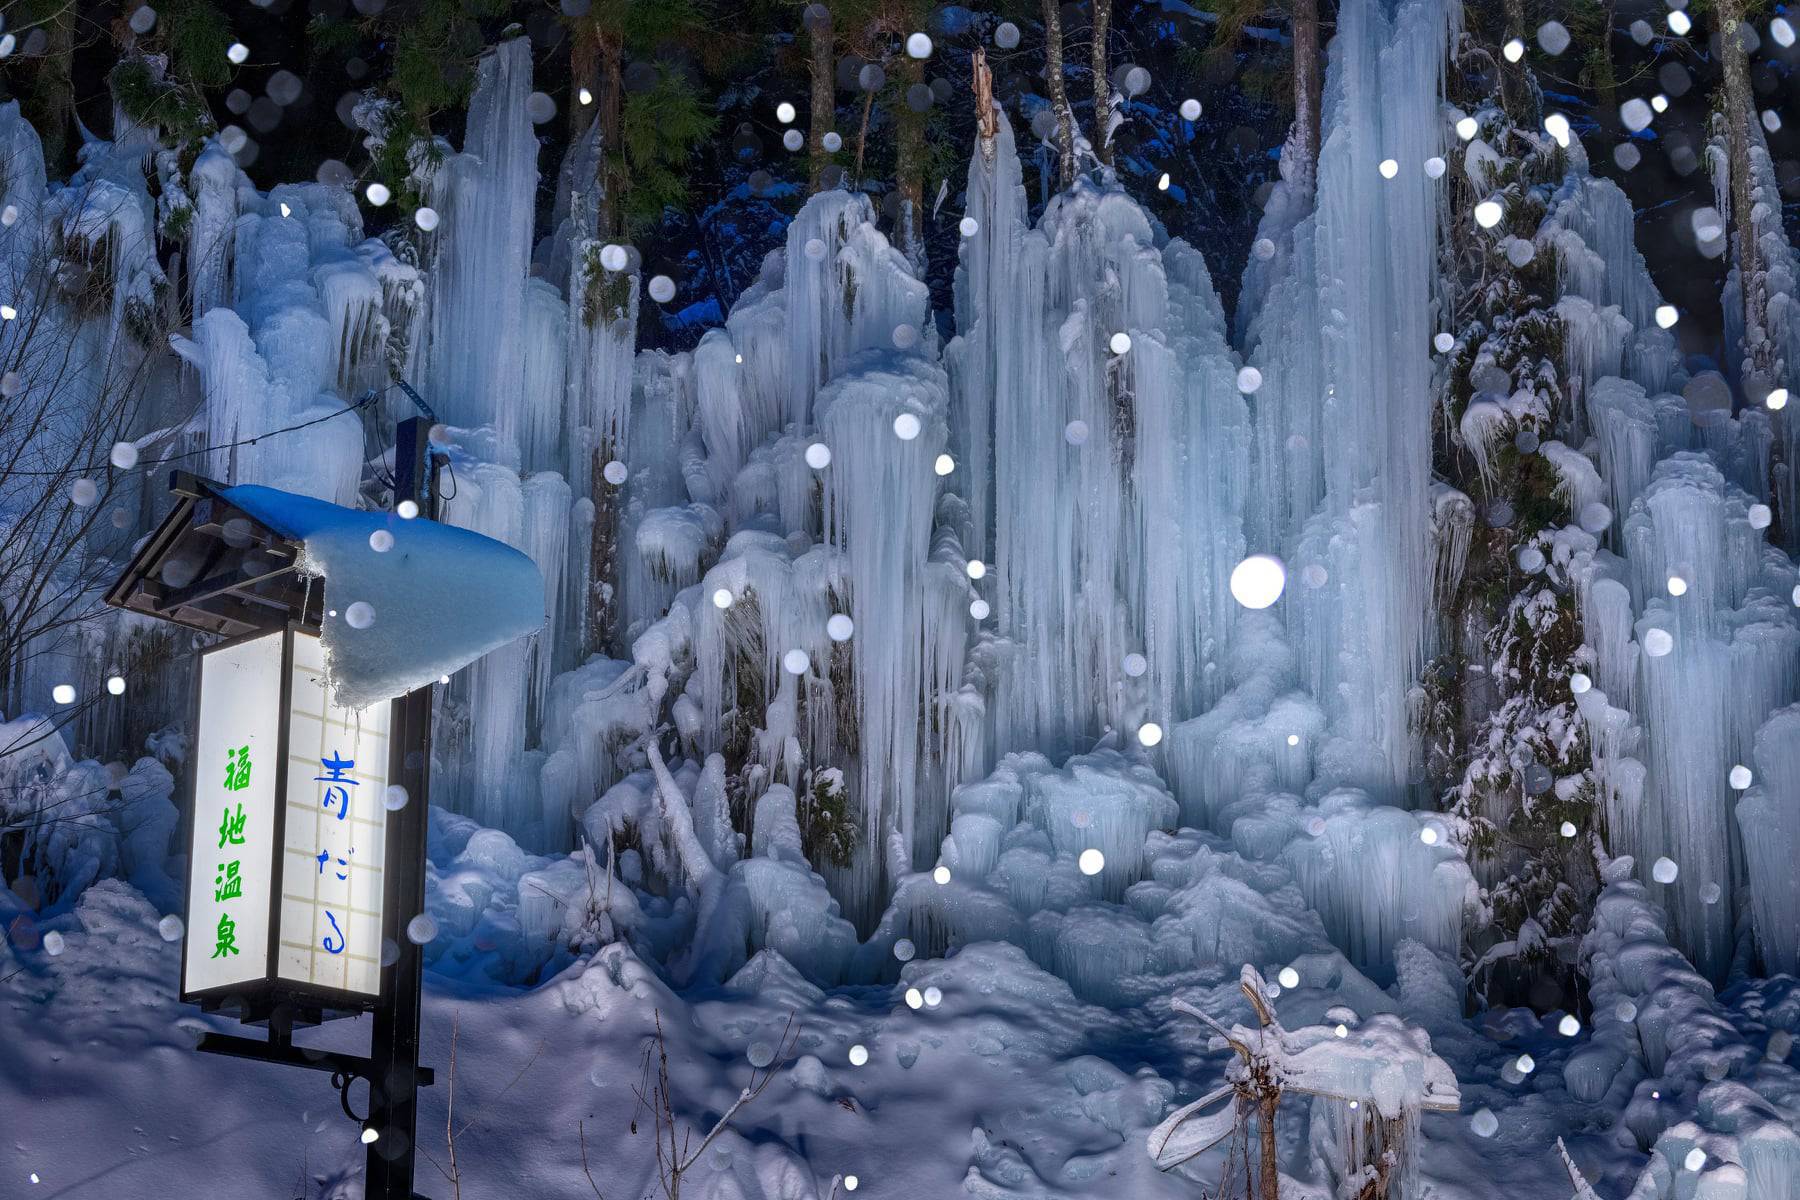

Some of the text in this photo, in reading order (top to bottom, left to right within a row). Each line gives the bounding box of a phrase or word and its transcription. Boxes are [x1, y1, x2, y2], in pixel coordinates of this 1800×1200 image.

[211, 745, 252, 959] 福地温泉
[314, 750, 360, 955] 青だる
